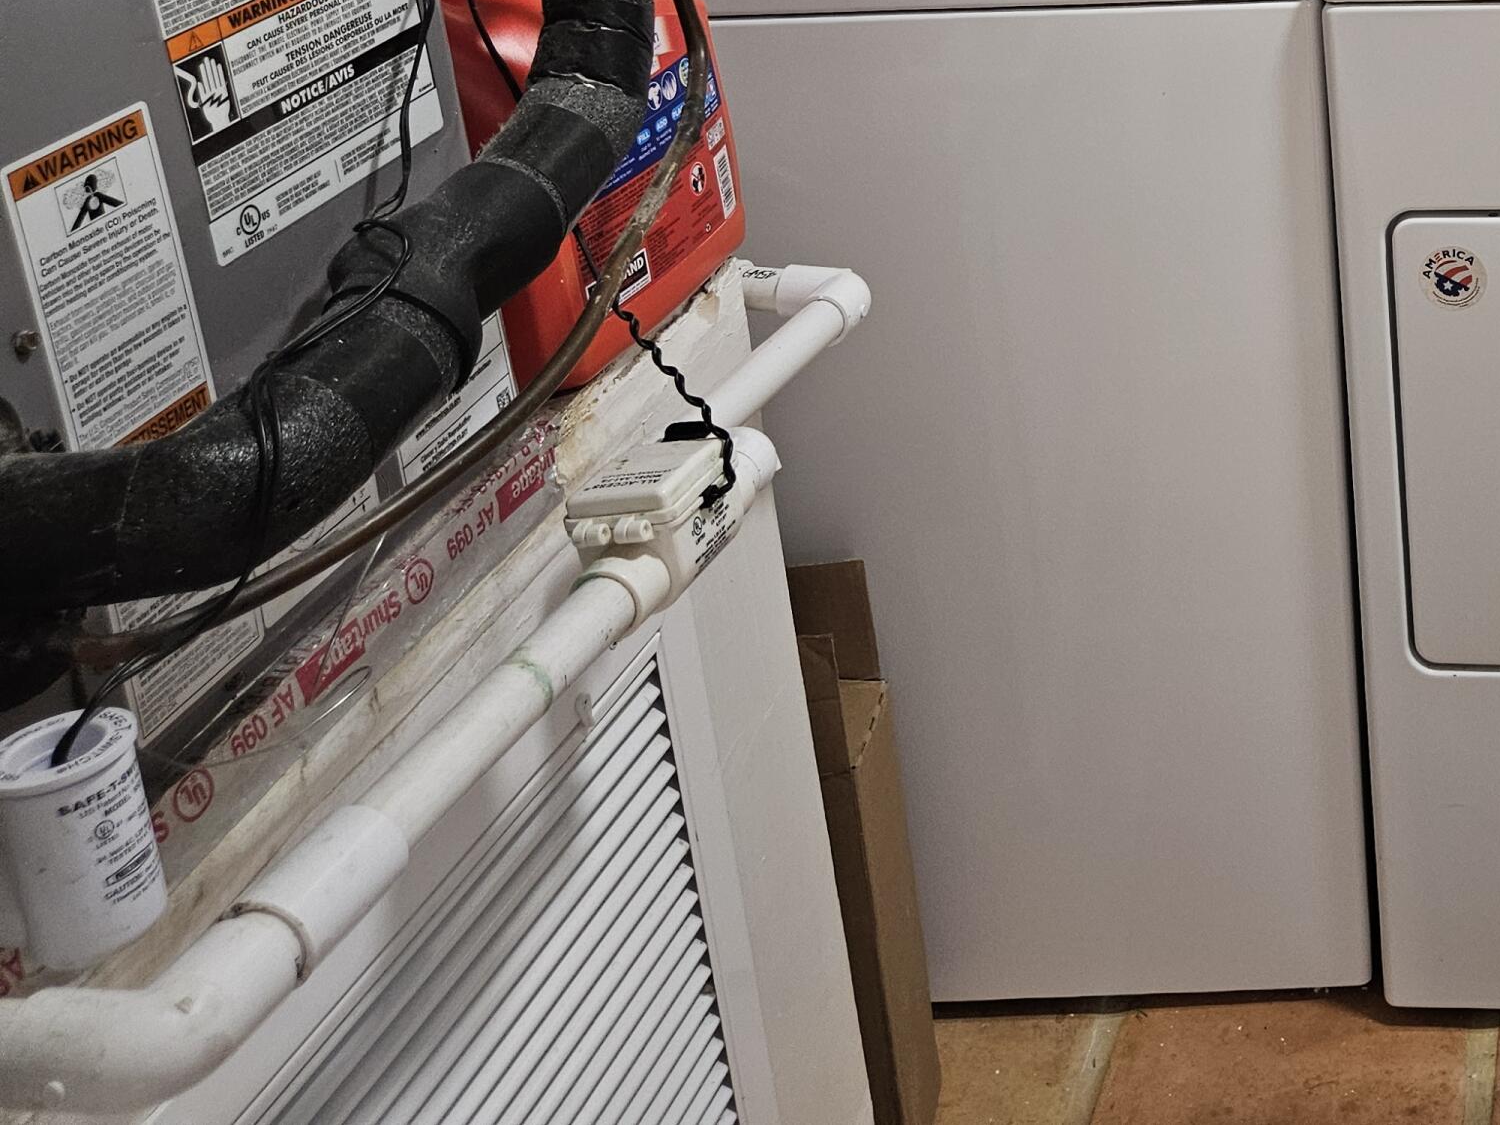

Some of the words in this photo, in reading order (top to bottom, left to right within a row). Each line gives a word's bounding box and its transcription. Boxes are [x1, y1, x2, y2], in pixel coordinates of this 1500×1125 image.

[246, 36, 262, 50] CAN
[262, 25, 284, 42] CAUSE
[285, 13, 308, 31] SEVERE
[251, 74, 269, 90] PEUT
[269, 61, 294, 81] CAUSER
[295, 54, 308, 67] DES
[334, 20, 374, 47] CORPORELLES
[374, 15, 384, 26] OU
[384, 11, 392, 21] LA
[392, 2, 408, 16] MORT
[285, 36, 321, 63] TENSION
[322, 10, 372, 44] DANGEREUSE
[280, 62, 355, 116] NOTICE/AVIS
[36, 116, 138, 184] WARNING
[39, 244, 67, 268] Carbon
[67, 224, 104, 252] Monoxide
[104, 215, 121, 232] (CO)
[121, 195, 156, 222] Poisoning
[244, 230, 265, 248] LISTED
[261, 209, 271, 221] US
[40, 261, 57, 278] Can
[56, 248, 81, 269] Cause
[81, 233, 108, 255] Severe
[107, 222, 128, 241] Injury
[128, 217, 137, 229] or
[1423, 249, 1474, 279] AMERICA
[128, 387, 209, 441] TISSEMENT
[447, 524, 473, 560] 099
[476, 501, 494, 536] AF
[320, 589, 402, 681] Shurtape
[272, 683, 295, 728] AF
[230, 712, 268, 757] 099
